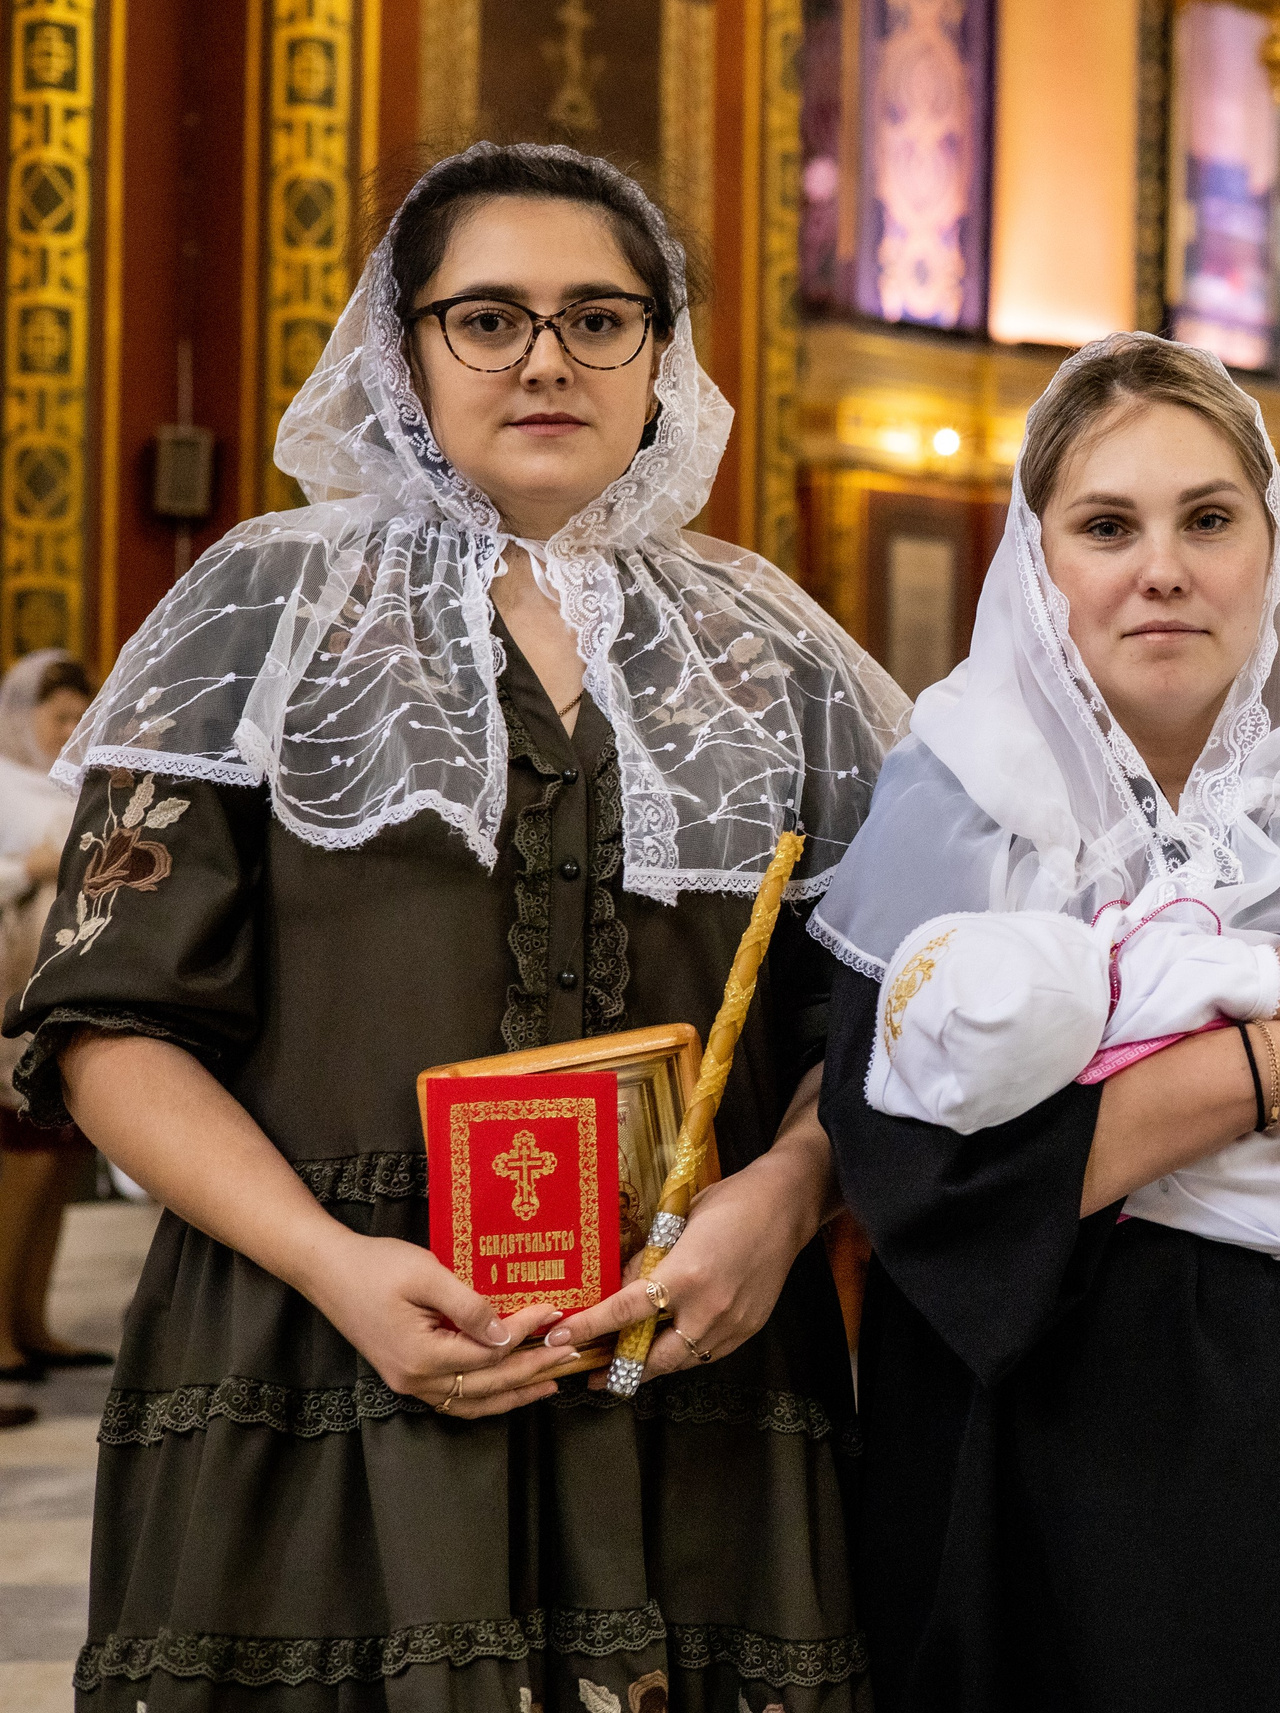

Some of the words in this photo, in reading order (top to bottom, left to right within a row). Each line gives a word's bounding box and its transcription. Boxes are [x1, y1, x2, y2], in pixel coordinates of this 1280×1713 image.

[479, 1230, 575, 1258] СВИДЕТЕЛЬСТВО
[490, 1263, 498, 1285] О
[506, 1259, 566, 1285] КРЕЩЕНИИ
